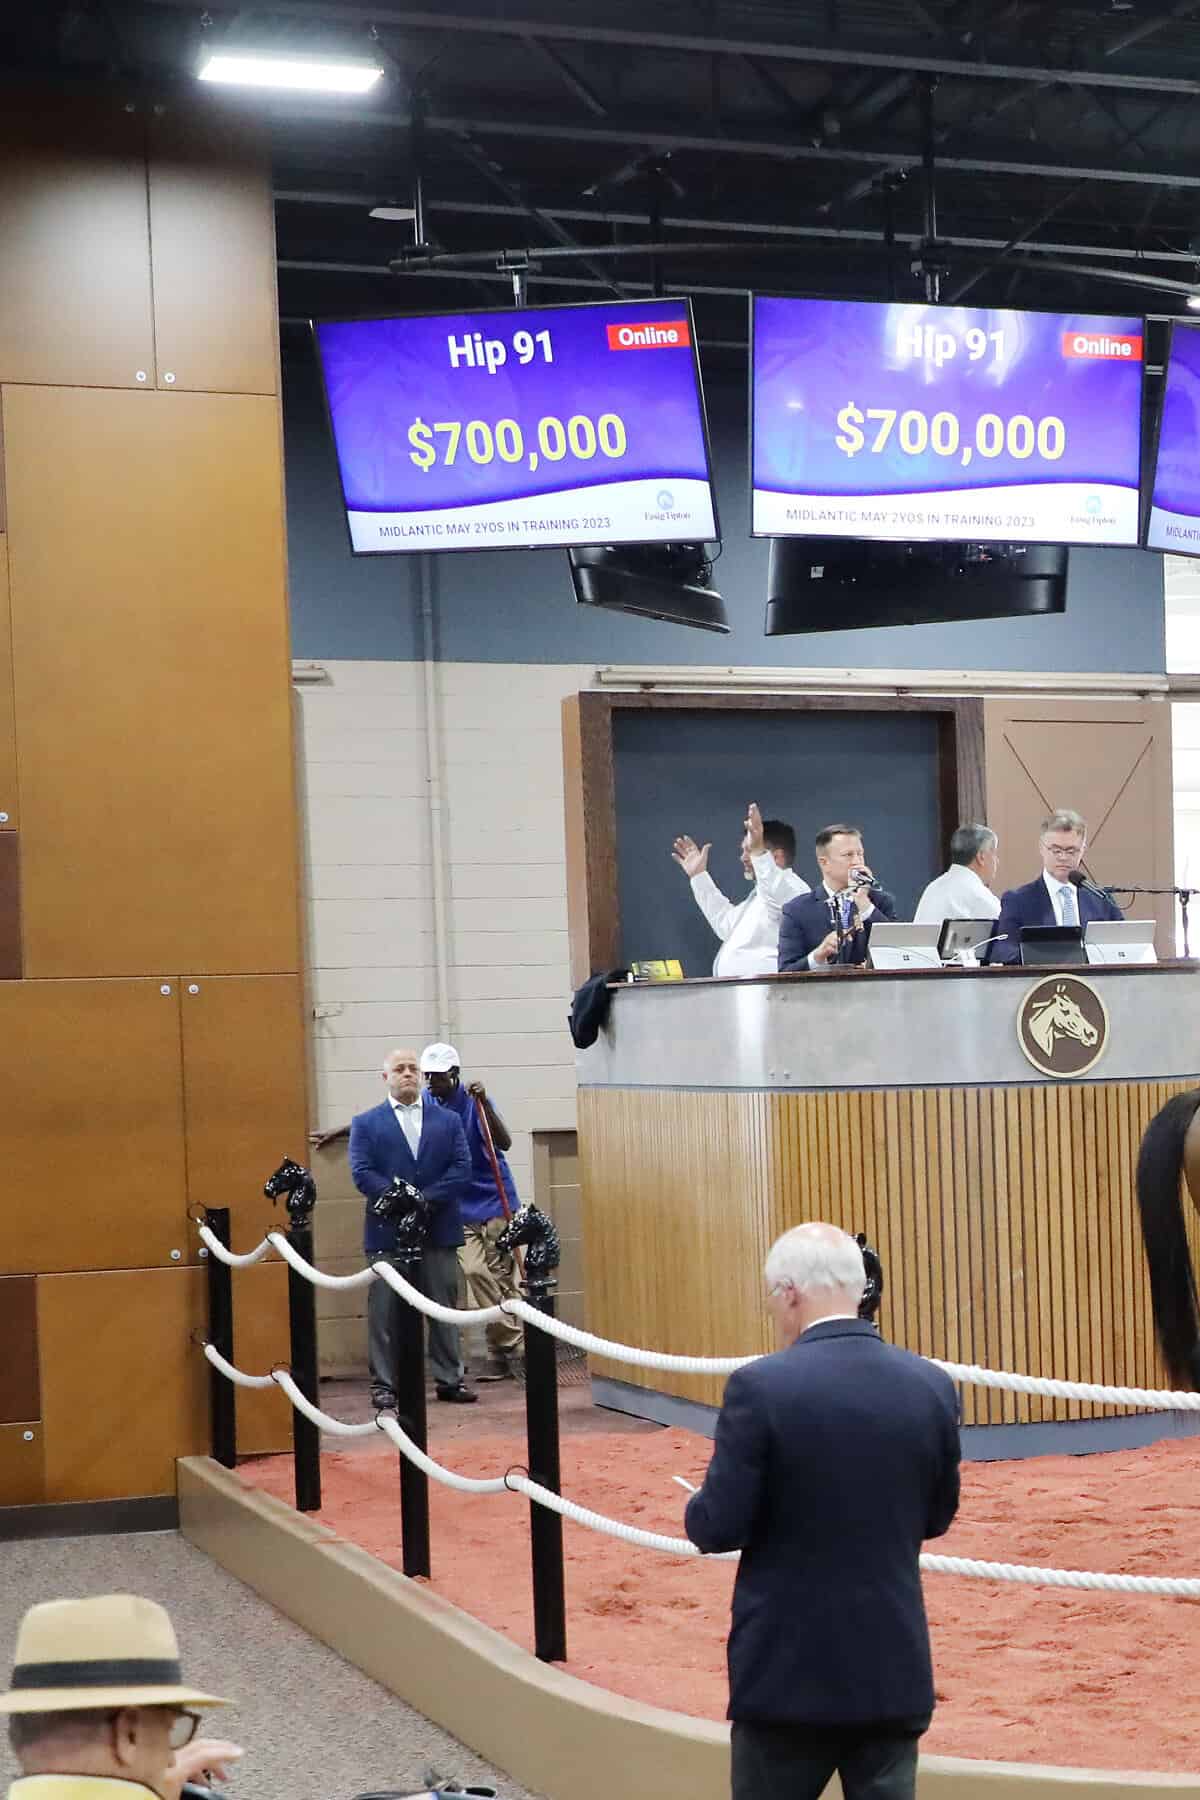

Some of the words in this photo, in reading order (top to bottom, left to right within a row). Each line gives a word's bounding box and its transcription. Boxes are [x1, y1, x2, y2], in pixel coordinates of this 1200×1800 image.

[618, 326, 678, 346] Online
[896, 324, 956, 368] Hip
[965, 328, 1007, 361] 91
[1073, 337, 1132, 357] Online
[448, 332, 507, 375] Hip
[513, 330, 553, 364] 91
[407, 413, 627, 472] $700,000
[835, 401, 1066, 467] $700,000
[379, 524, 444, 537] MIDLANTIC
[445, 523, 472, 535] MAY
[507, 520, 520, 532] IN
[522, 518, 580, 532] TRAINING
[582, 517, 612, 530] 2023
[786, 508, 857, 521] MIDLANTIC
[861, 511, 887, 522] MAY
[927, 512, 940, 524] IN
[944, 514, 1002, 526] TRAINING
[1006, 515, 1035, 528] 2023
